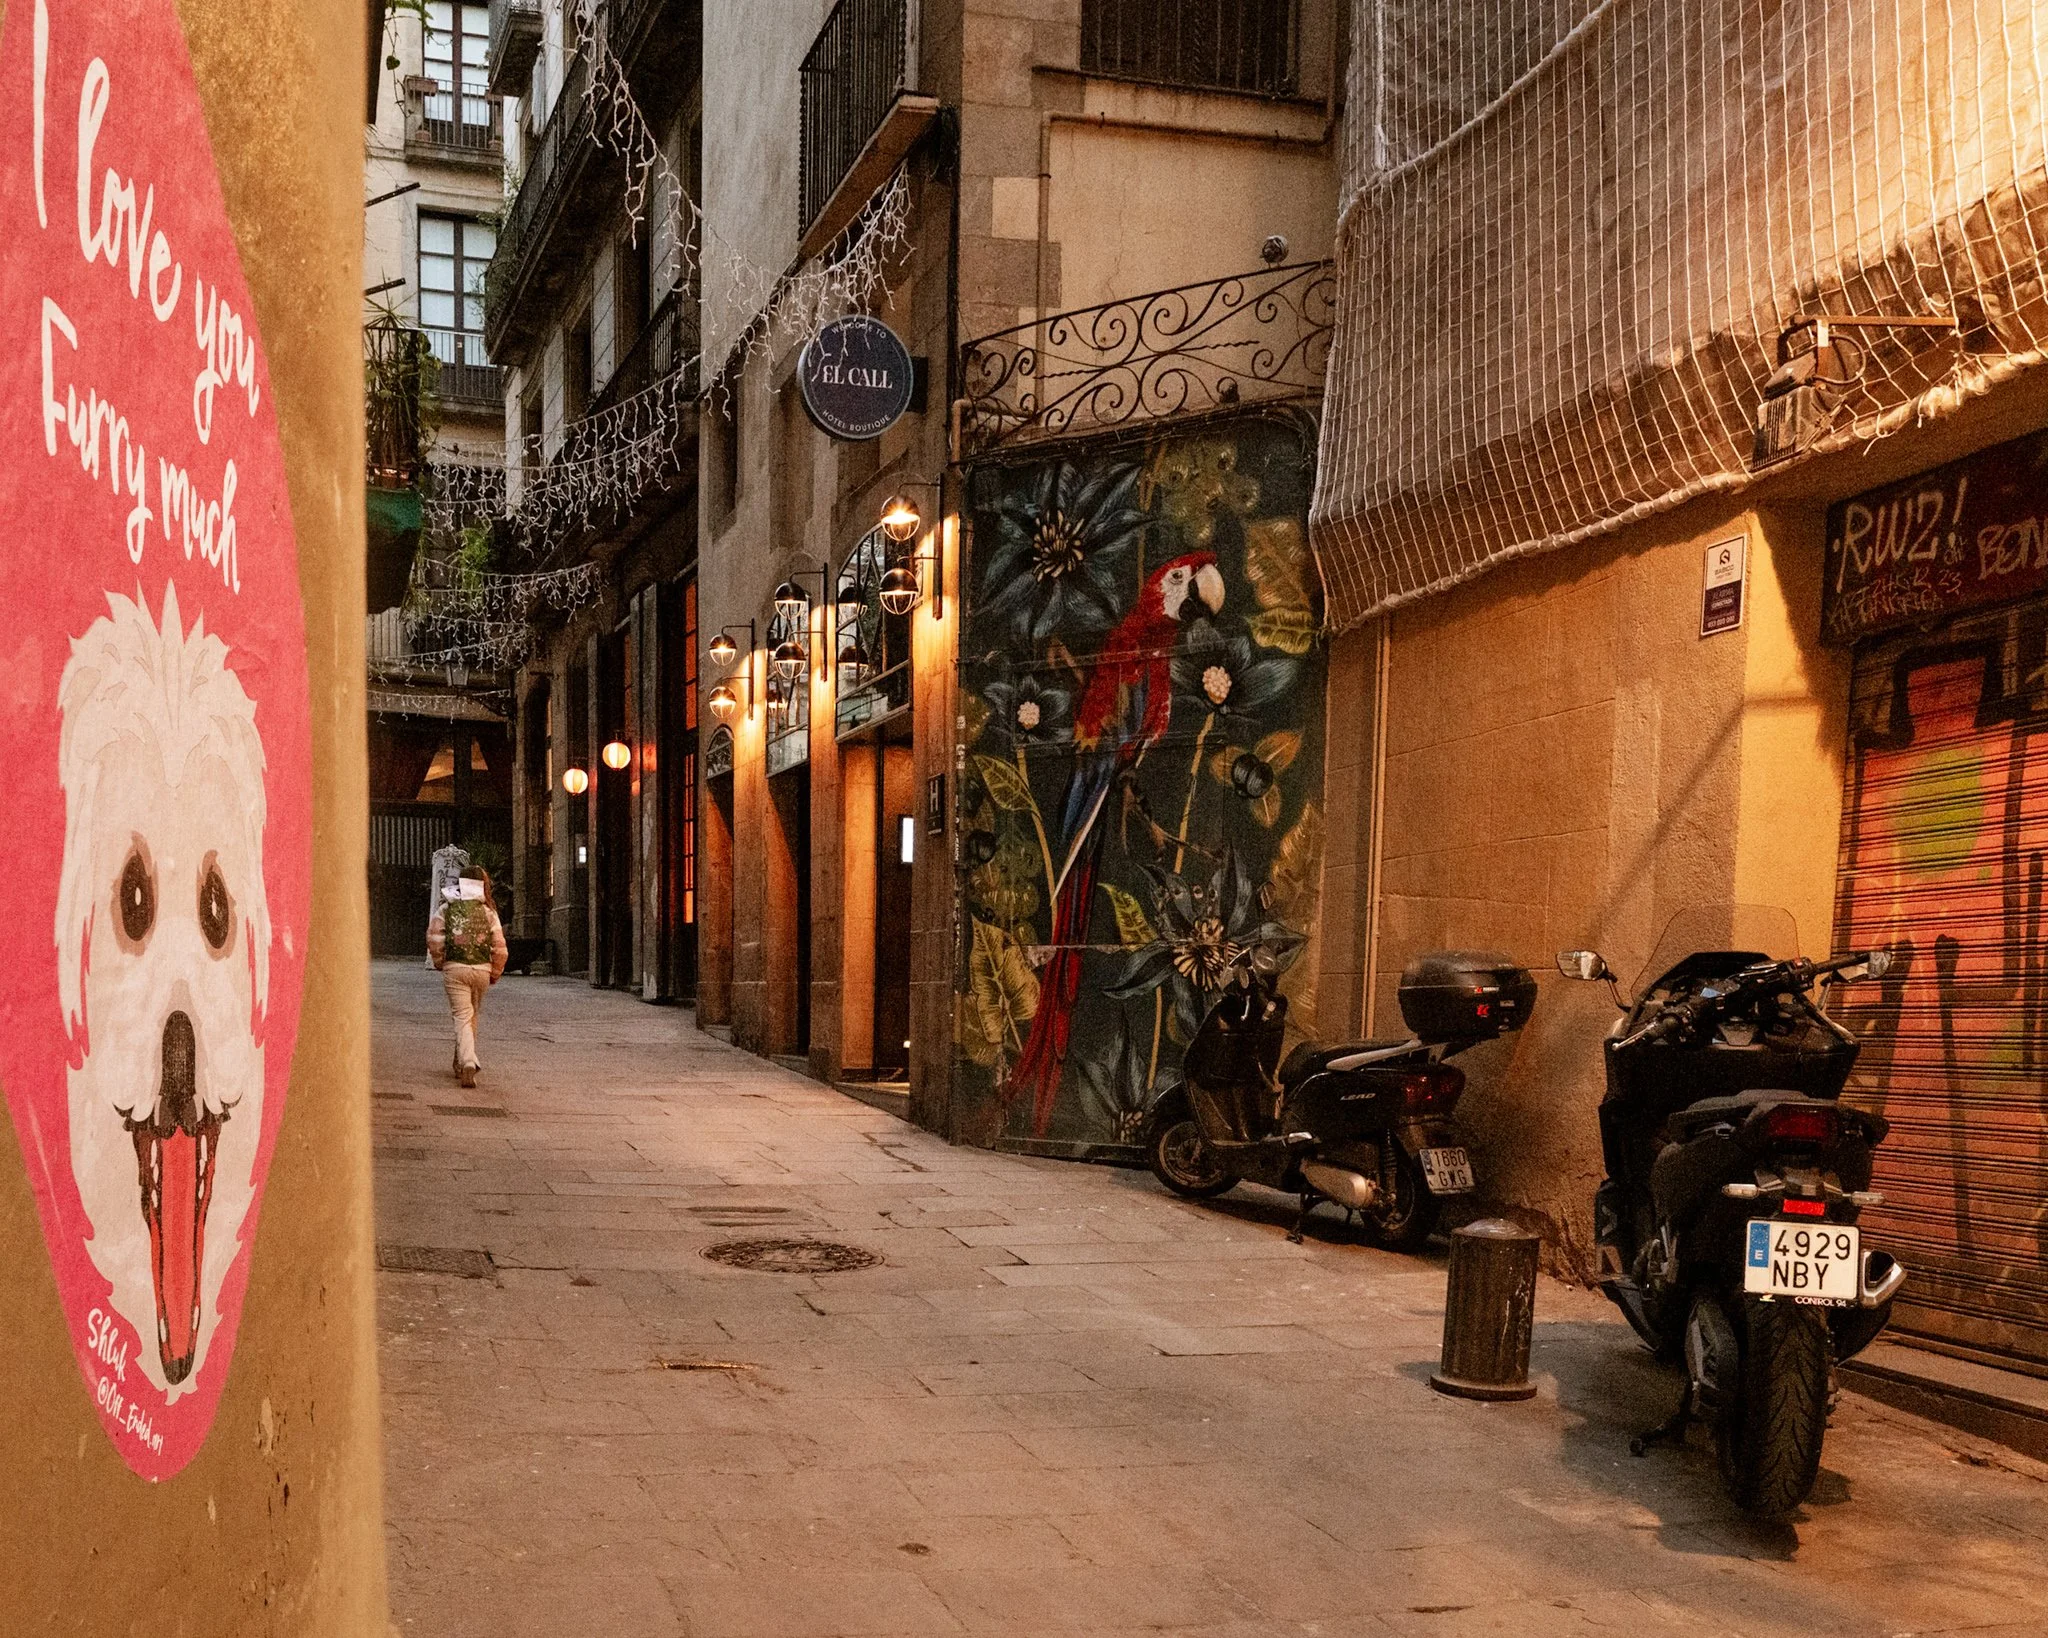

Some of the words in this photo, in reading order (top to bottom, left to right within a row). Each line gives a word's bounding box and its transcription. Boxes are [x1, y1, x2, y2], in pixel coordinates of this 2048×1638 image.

[33, 0, 49, 229] I
[78, 57, 182, 322] love
[194, 273, 260, 444] you
[876, 329, 887, 339] TO
[822, 364, 845, 385] EL
[848, 367, 893, 389] CALL
[822, 409, 846, 429] HOTEL
[849, 414, 891, 432] BOUTIQUE
[41, 296, 153, 564] Furry
[159, 458, 240, 594] much
[930, 779, 938, 813] H
[1754, 1250, 1764, 1261] E
[1774, 1229, 1851, 1261] 4929
[1772, 1260, 1829, 1290] NBY
[1795, 1296, 1835, 1307] CONTROL
[1836, 1299, 1847, 1308] 94
